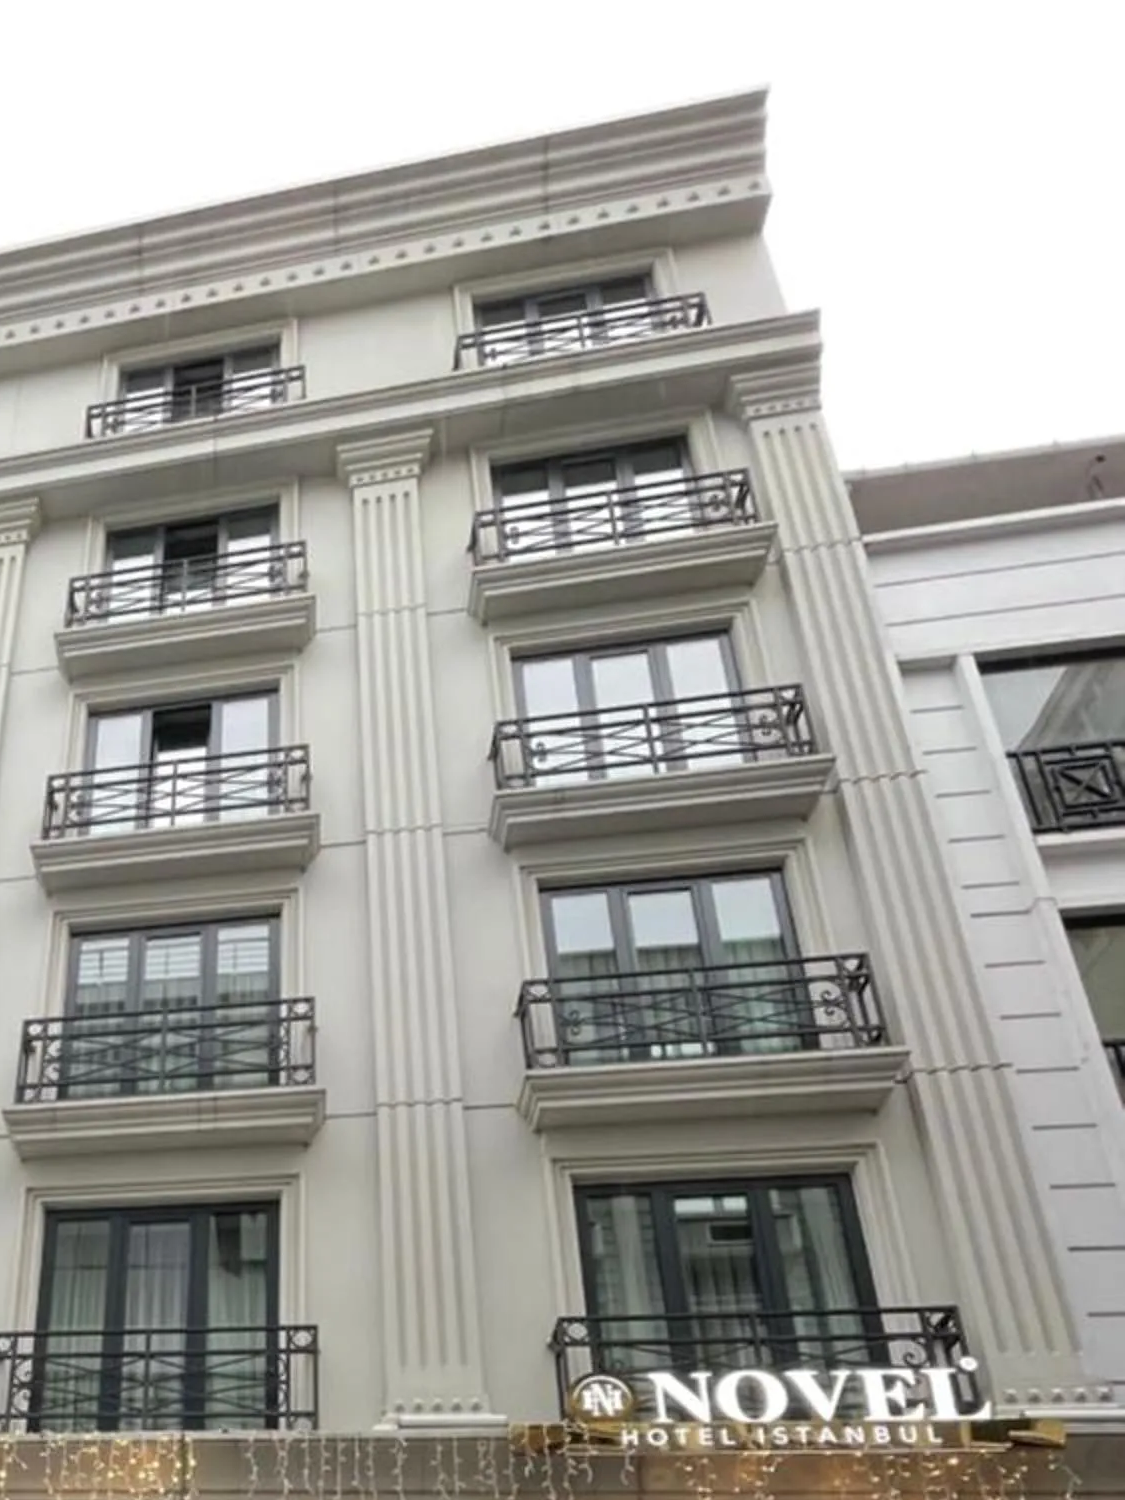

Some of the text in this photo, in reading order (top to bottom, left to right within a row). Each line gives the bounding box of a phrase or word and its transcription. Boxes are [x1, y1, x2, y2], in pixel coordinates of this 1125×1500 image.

[647, 1367, 993, 1422] NOVEL
[621, 1425, 943, 1446] HOTEL ISTANBUL
